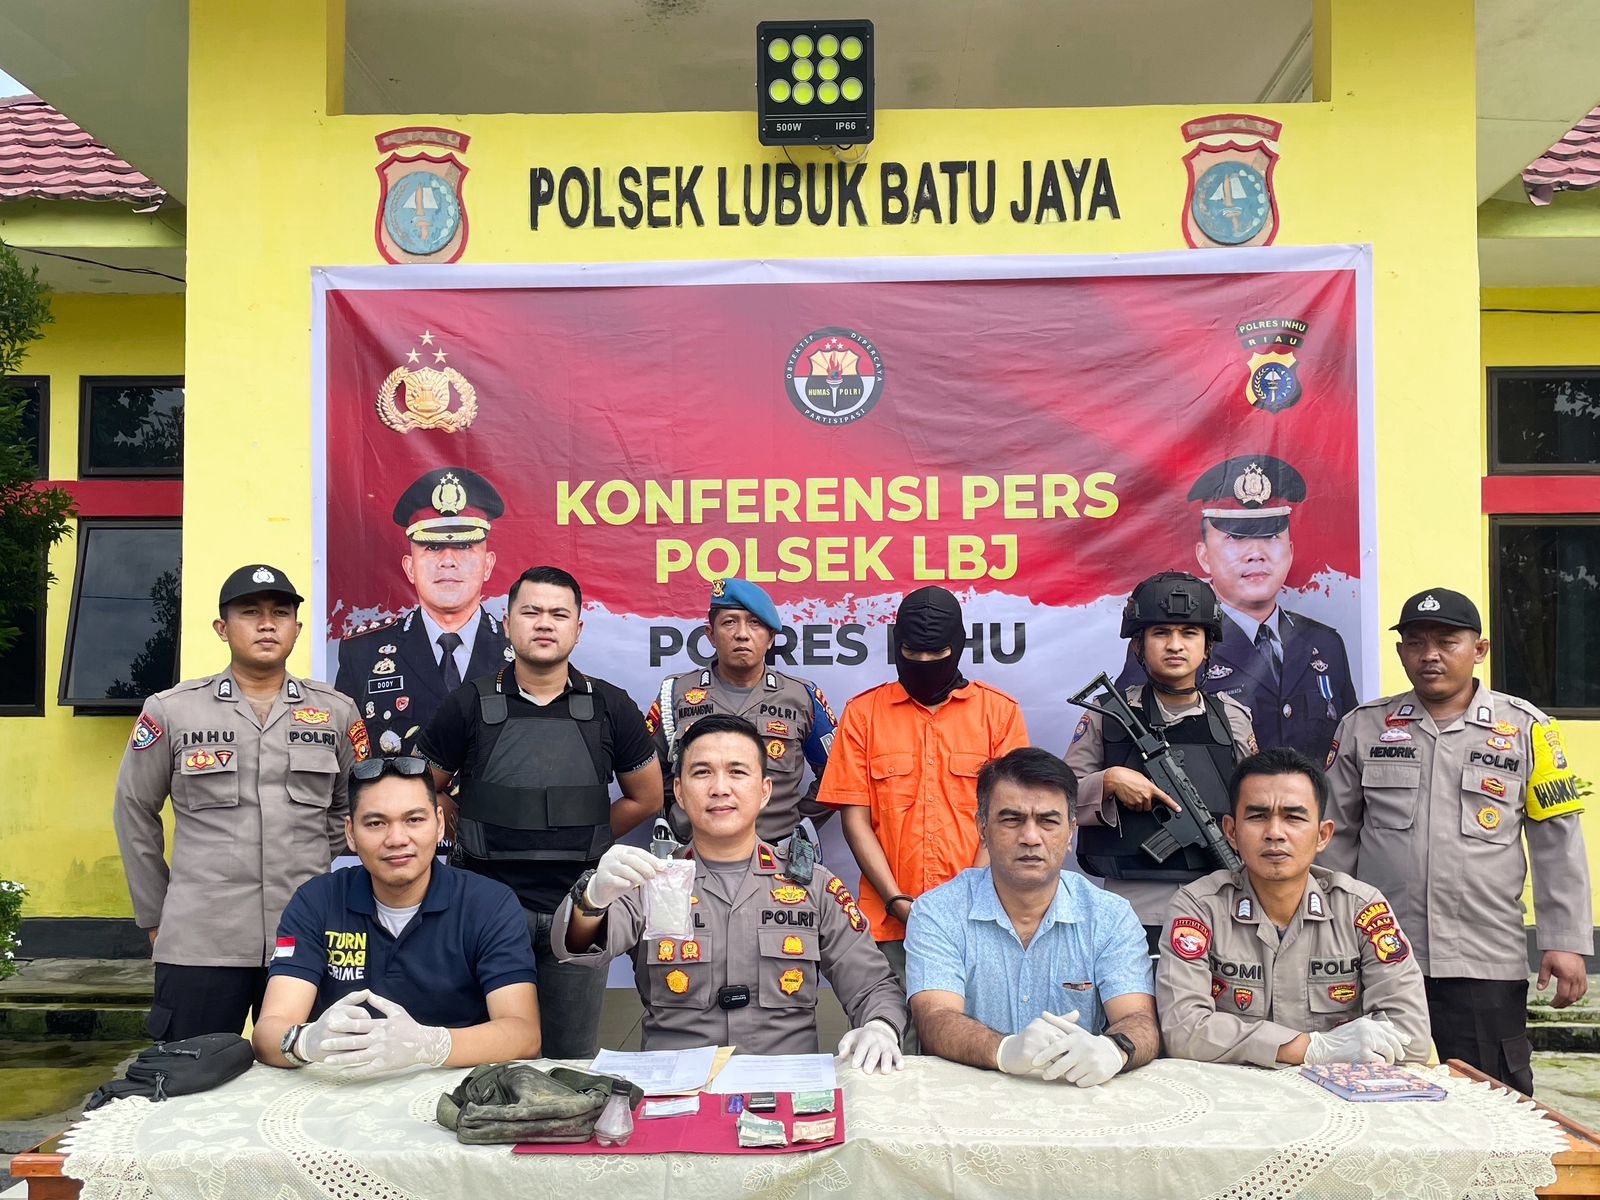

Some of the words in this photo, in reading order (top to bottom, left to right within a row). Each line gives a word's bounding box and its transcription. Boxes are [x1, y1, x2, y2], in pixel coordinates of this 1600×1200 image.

[776, 123, 802, 132] 500W
[835, 121, 857, 131] IP66
[529, 164, 704, 231] POLSEK
[718, 162, 867, 226] LUBUK
[880, 161, 995, 224] BATU
[1010, 157, 1121, 225] JAYA
[1239, 320, 1278, 333] POLRES
[1281, 320, 1306, 332] INHU
[1248, 335, 1297, 346] RIAU
[786, 334, 814, 379] OBYEKTIF
[850, 332, 883, 382] DIPERCAYA
[808, 388, 831, 396] HUMAS
[804, 408, 866, 425] PARTISIPASI
[556, 475, 940, 526] KONFERENSI
[962, 472, 1119, 520] PERS
[655, 537, 894, 584] POLSEK
[913, 533, 1018, 581] LBJ
[650, 624, 868, 667] PORES
[887, 622, 1026, 665] IHU
[377, 681, 394, 689] DODY
[760, 704, 797, 720] POLRI
[183, 730, 235, 745] INHU
[289, 732, 336, 746] POLRI
[1370, 746, 1417, 759] HENDRIK
[1470, 751, 1520, 772] POLRI
[761, 910, 815, 928] POLRI
[1366, 918, 1391, 931] RIAU
[325, 930, 367, 950] TURN
[327, 964, 365, 981] CRIME
[1209, 954, 1262, 980] TOMI
[1311, 957, 1361, 975] POLR
